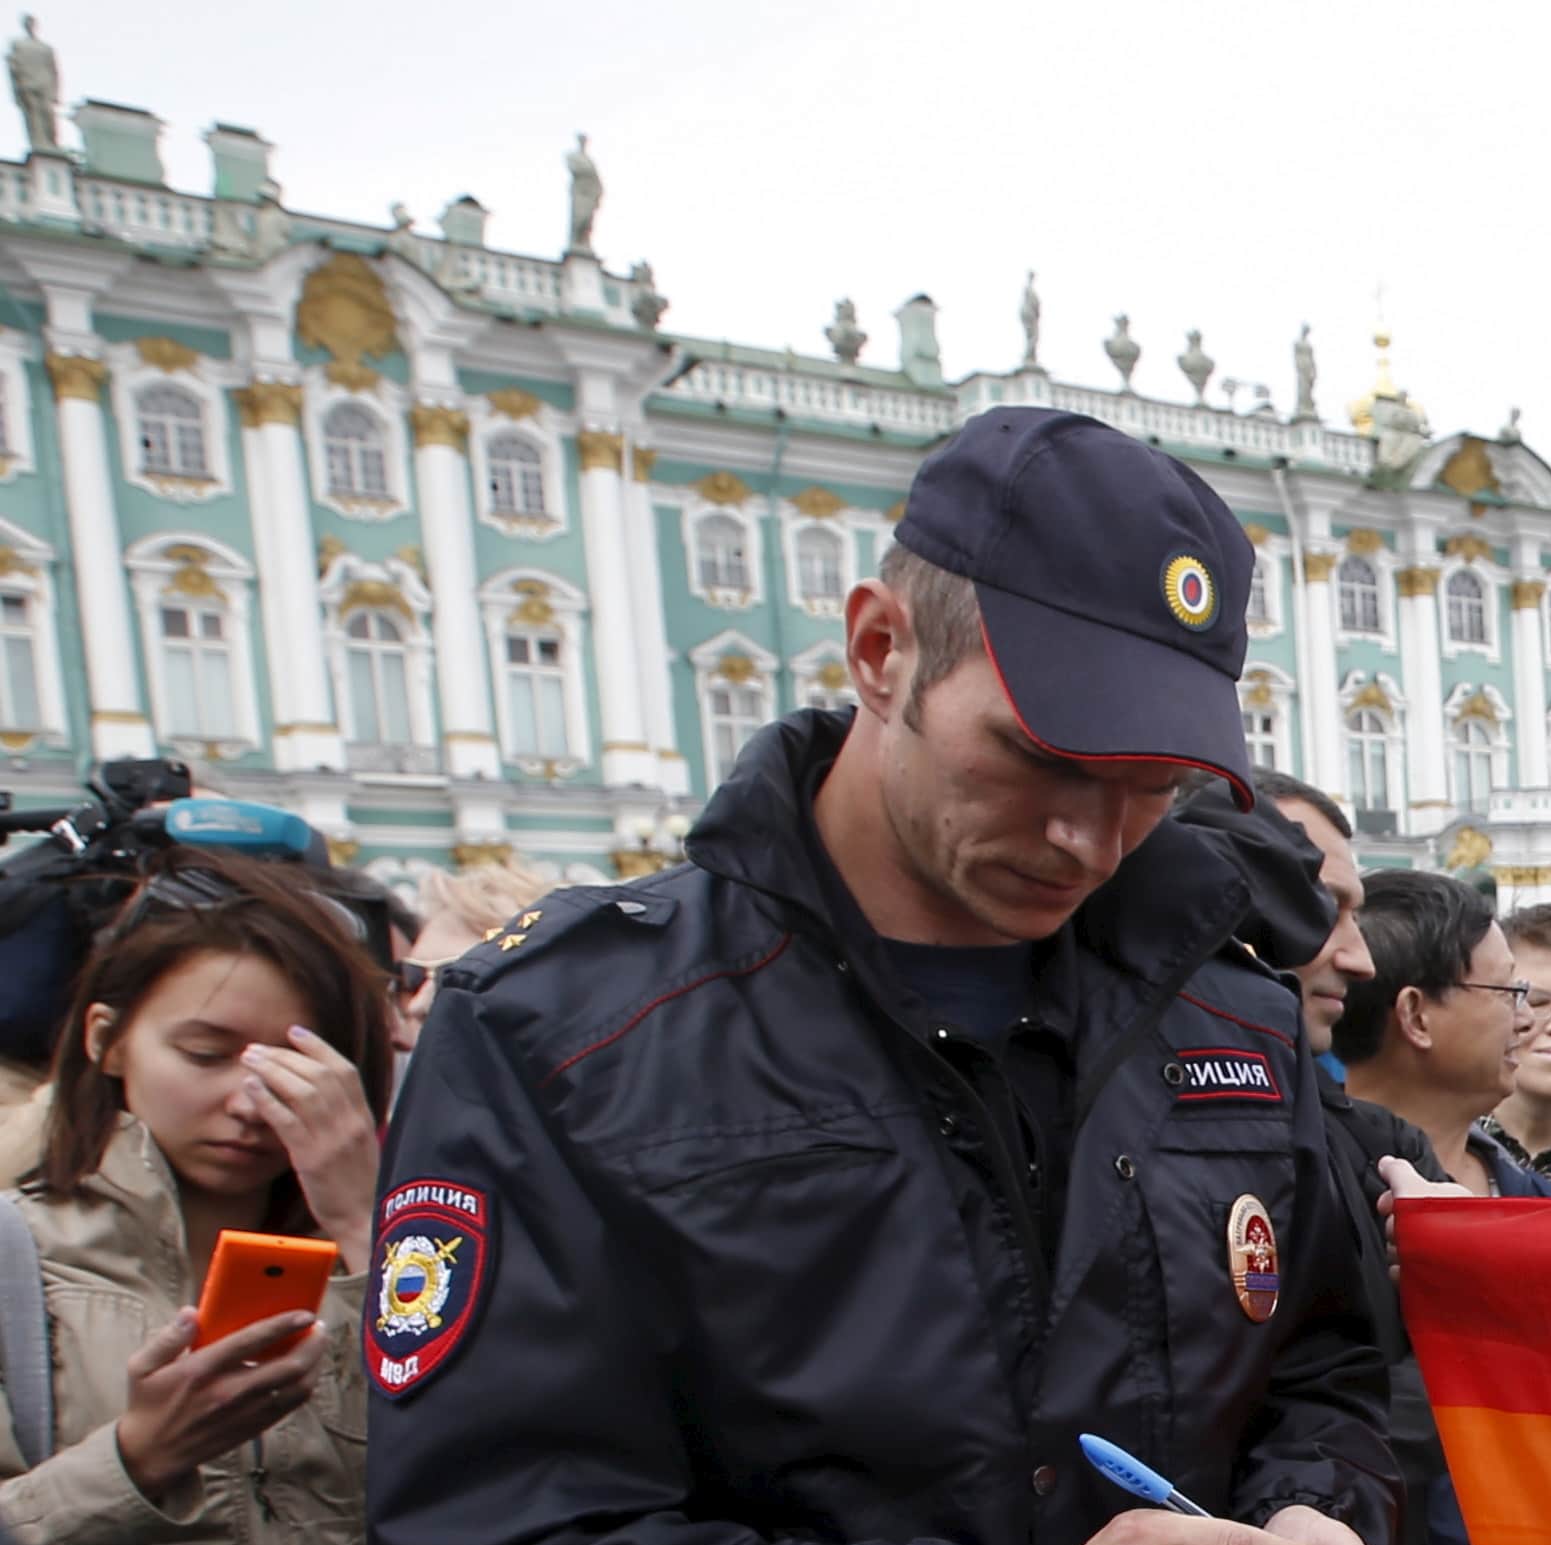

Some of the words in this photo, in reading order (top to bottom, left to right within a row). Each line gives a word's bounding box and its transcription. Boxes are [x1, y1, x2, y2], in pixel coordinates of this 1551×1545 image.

[1184, 1061, 1270, 1087] ИЦИЯ
[385, 1186, 478, 1220] ПОЛИЦИЯ
[380, 1355, 419, 1385] МВД
